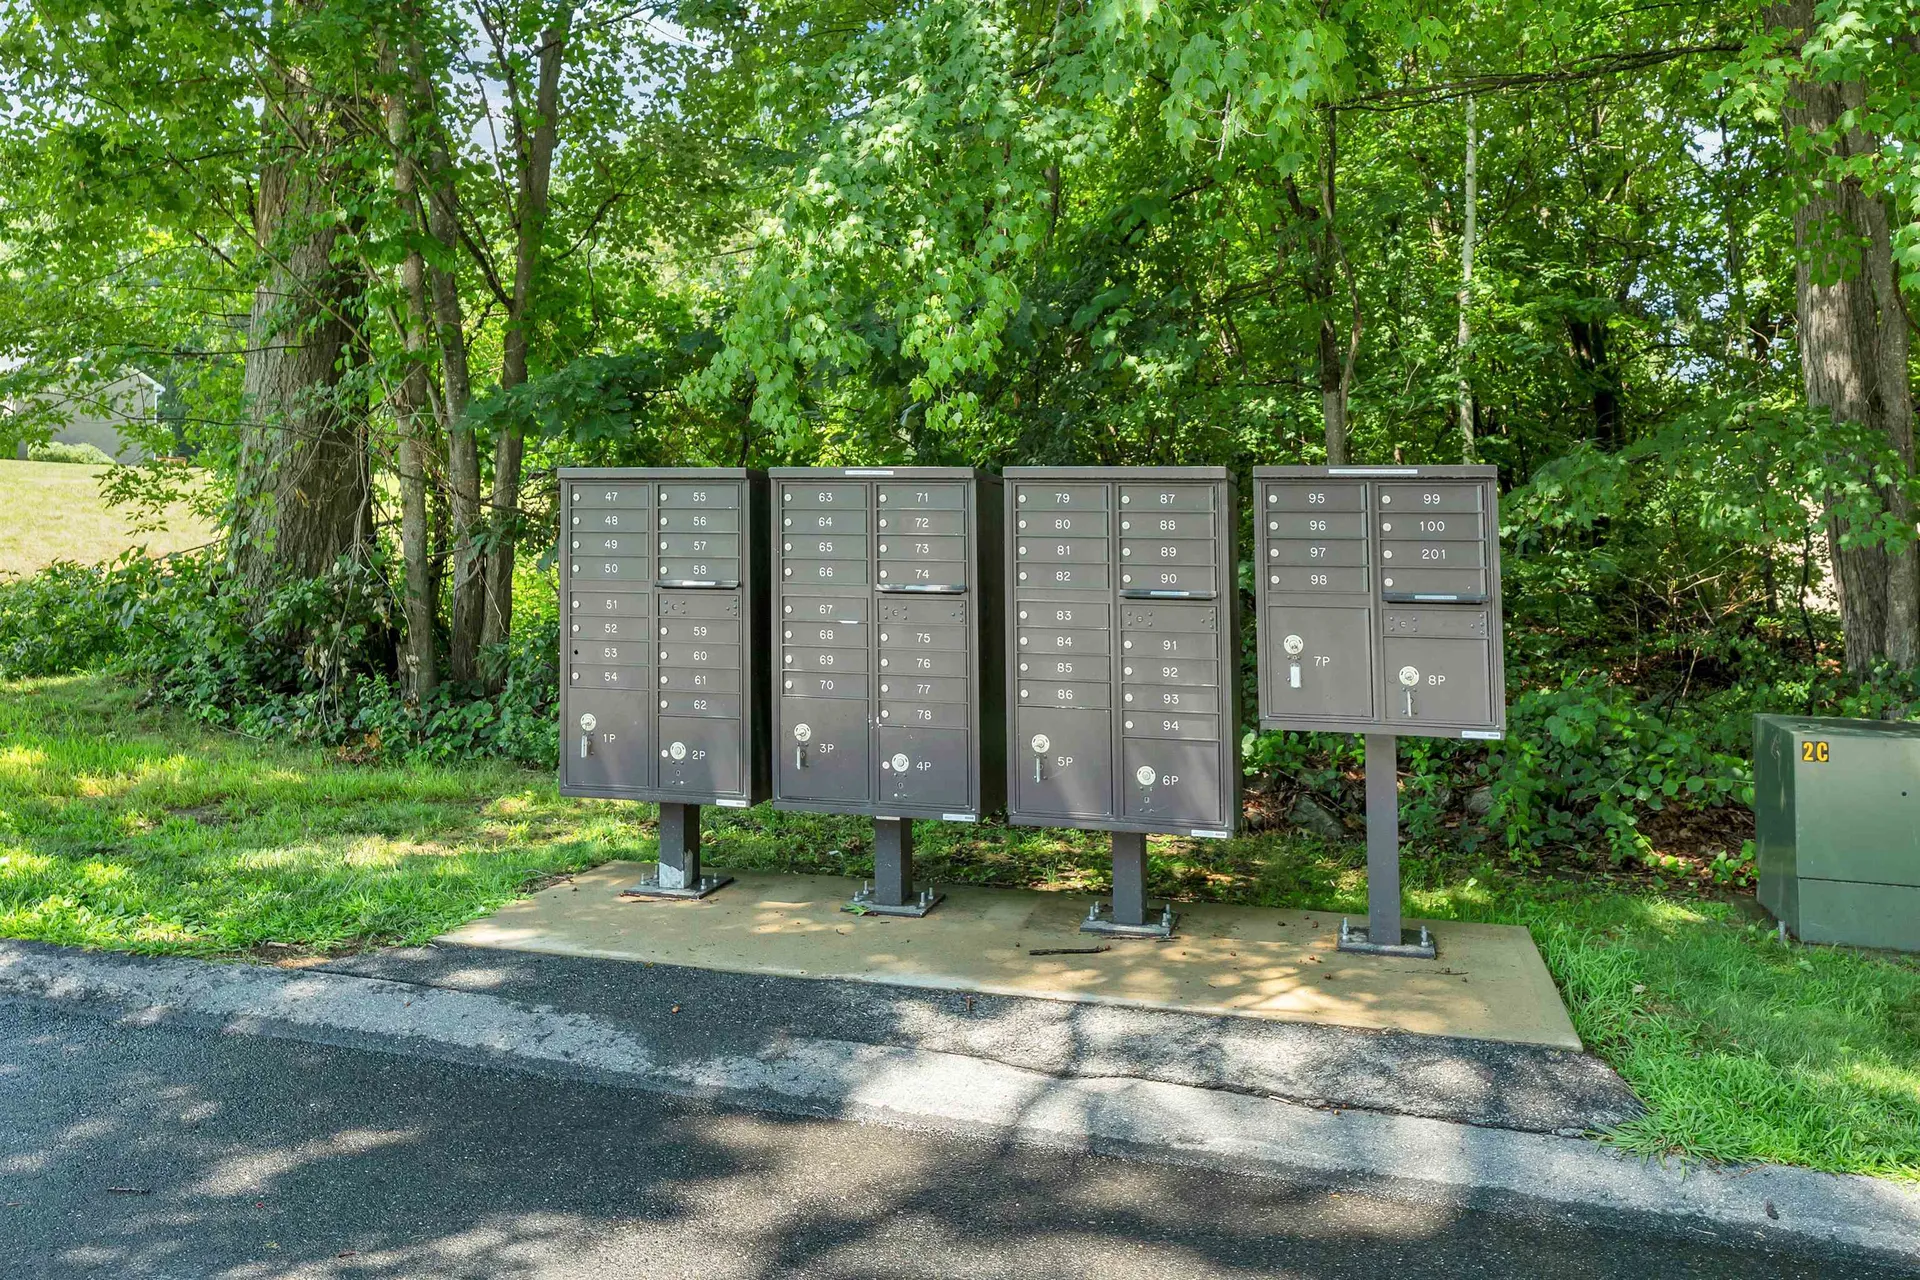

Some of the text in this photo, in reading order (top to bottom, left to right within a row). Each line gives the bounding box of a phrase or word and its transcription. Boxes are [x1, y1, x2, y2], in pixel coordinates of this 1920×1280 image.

[604, 491, 618, 502] 47
[692, 491, 707, 502] 55
[818, 492, 833, 503] 63
[916, 492, 929, 503] 71
[1055, 493, 1070, 504] 79
[1159, 493, 1176, 504] 87
[1308, 493, 1326, 504] 95
[1423, 493, 1441, 505] 99
[604, 515, 619, 526] 48
[693, 516, 707, 527] 56
[818, 516, 833, 527] 64
[915, 517, 930, 528] 72
[1054, 518, 1071, 530] 80
[1159, 519, 1176, 531] 88
[1309, 520, 1327, 531] 96
[1419, 520, 1445, 532] 100
[604, 539, 618, 550] 49
[693, 540, 707, 551] 57
[818, 541, 833, 553] 65
[915, 543, 930, 554] 73
[1056, 544, 1070, 556] 81
[1160, 546, 1177, 558] 89
[1309, 547, 1326, 558] 97
[1421, 548, 1446, 560] 201
[604, 563, 618, 574] 50
[693, 564, 707, 575] 58
[818, 566, 834, 578] 66
[915, 569, 930, 579] 74
[1055, 570, 1071, 582] 82
[1160, 573, 1177, 584] 90
[1310, 574, 1328, 586] 98
[605, 599, 617, 610] 51
[819, 604, 833, 615] 67
[1056, 610, 1072, 621] 83
[604, 623, 618, 634] 52
[693, 626, 707, 637] 59
[819, 629, 834, 640] 68
[916, 632, 931, 644] 75
[1056, 636, 1073, 647] 84
[1163, 639, 1177, 651] 91
[604, 647, 618, 658] 53
[693, 650, 708, 661] 60
[819, 654, 834, 666] 69
[916, 657, 931, 669] 76
[1313, 655, 1331, 667] 7P
[1056, 662, 1073, 673] 85
[1162, 666, 1179, 678] 92
[604, 671, 618, 682] 54
[694, 674, 706, 685] 61
[1428, 674, 1446, 686] 8P
[819, 679, 834, 690] 70
[916, 683, 931, 695] 77
[1057, 688, 1073, 700] 86
[1163, 693, 1180, 705] 93
[693, 699, 707, 710] 62
[916, 709, 932, 721] 78
[1162, 720, 1180, 731] 94
[603, 733, 616, 743] 1P
[819, 743, 835, 754] 3P
[1802, 741, 1829, 762] 2C
[692, 749, 706, 760] 2P
[916, 761, 932, 772] 4P
[1057, 756, 1074, 767] 5P
[1162, 774, 1179, 786] 6P
